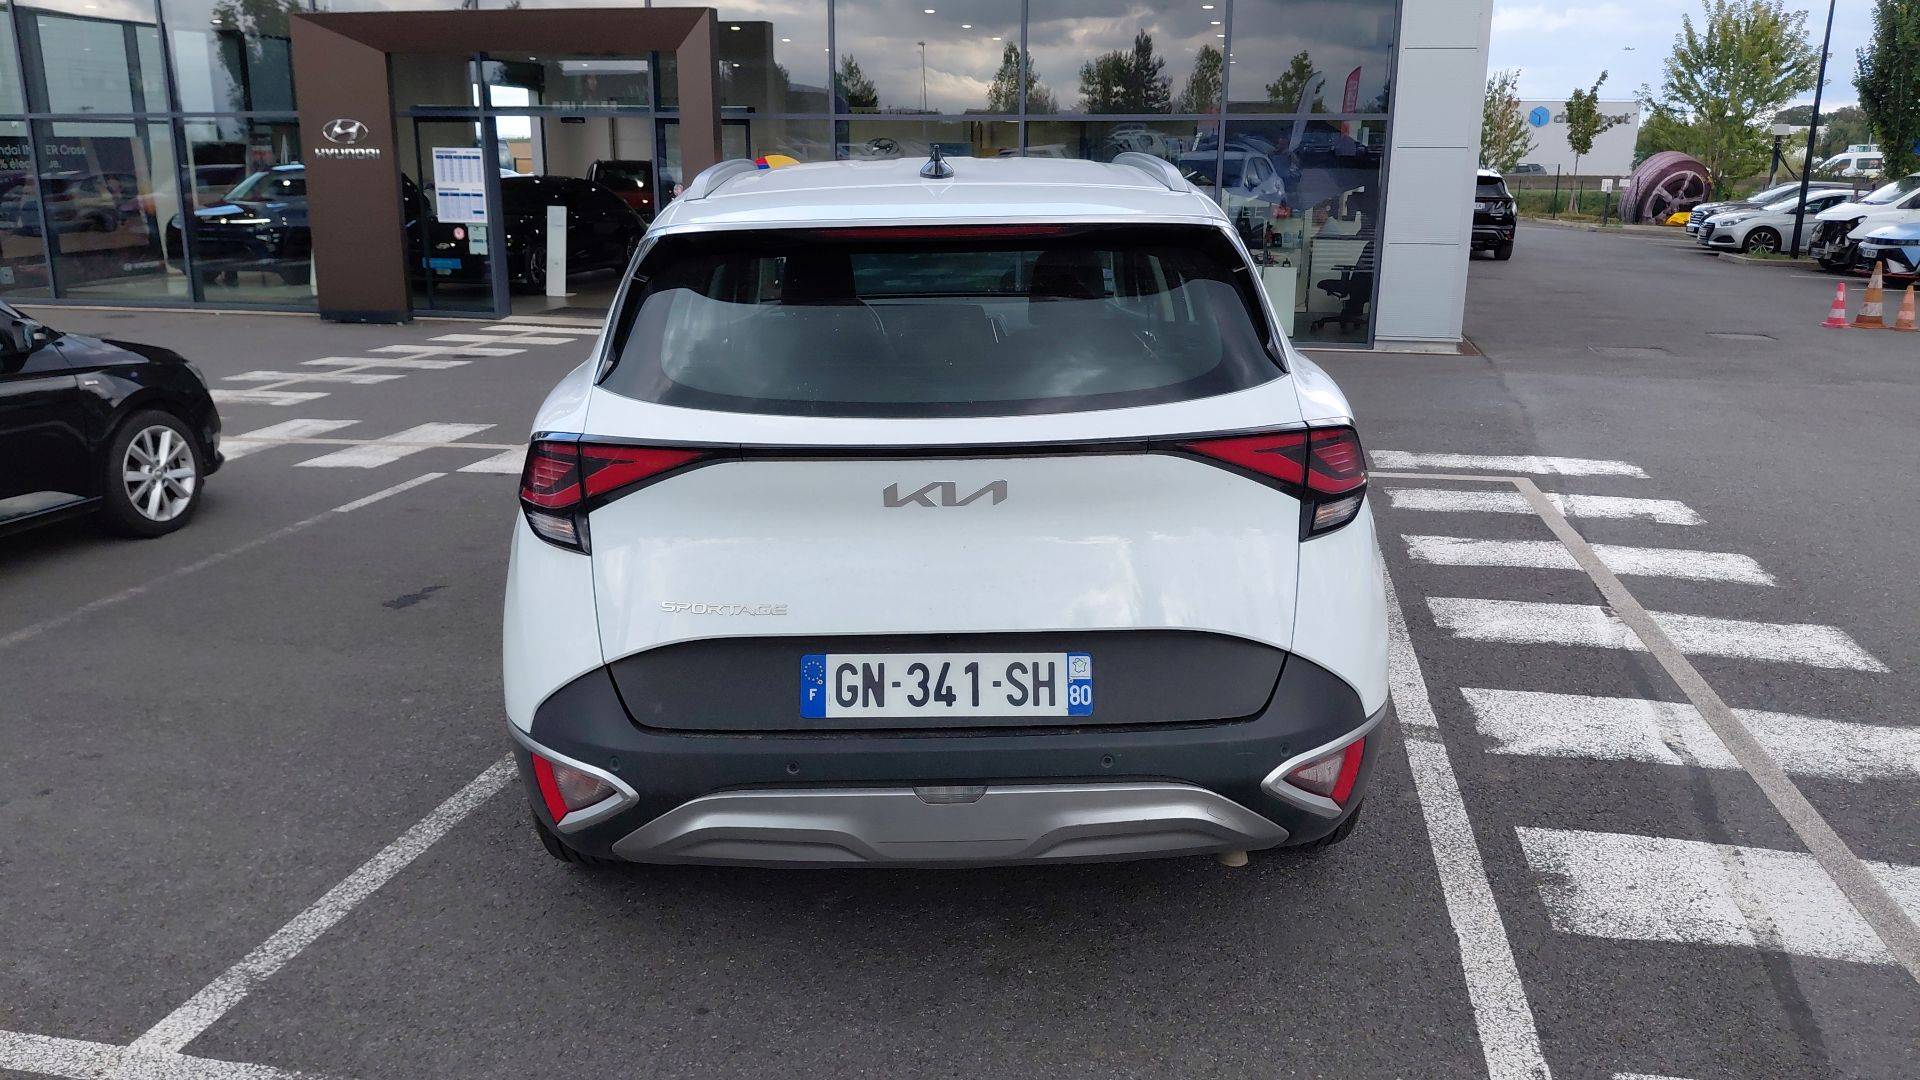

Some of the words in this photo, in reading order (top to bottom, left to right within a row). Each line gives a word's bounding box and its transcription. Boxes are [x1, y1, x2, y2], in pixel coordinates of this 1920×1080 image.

[60, 145, 87, 155] Cross
[314, 148, 380, 159] HYUNDAI
[883, 480, 1008, 507] KIA
[661, 600, 788, 616] SPORTAGE
[809, 688, 818, 701] F
[835, 661, 1056, 707] GN-341-SH
[1069, 684, 1092, 706] 80
